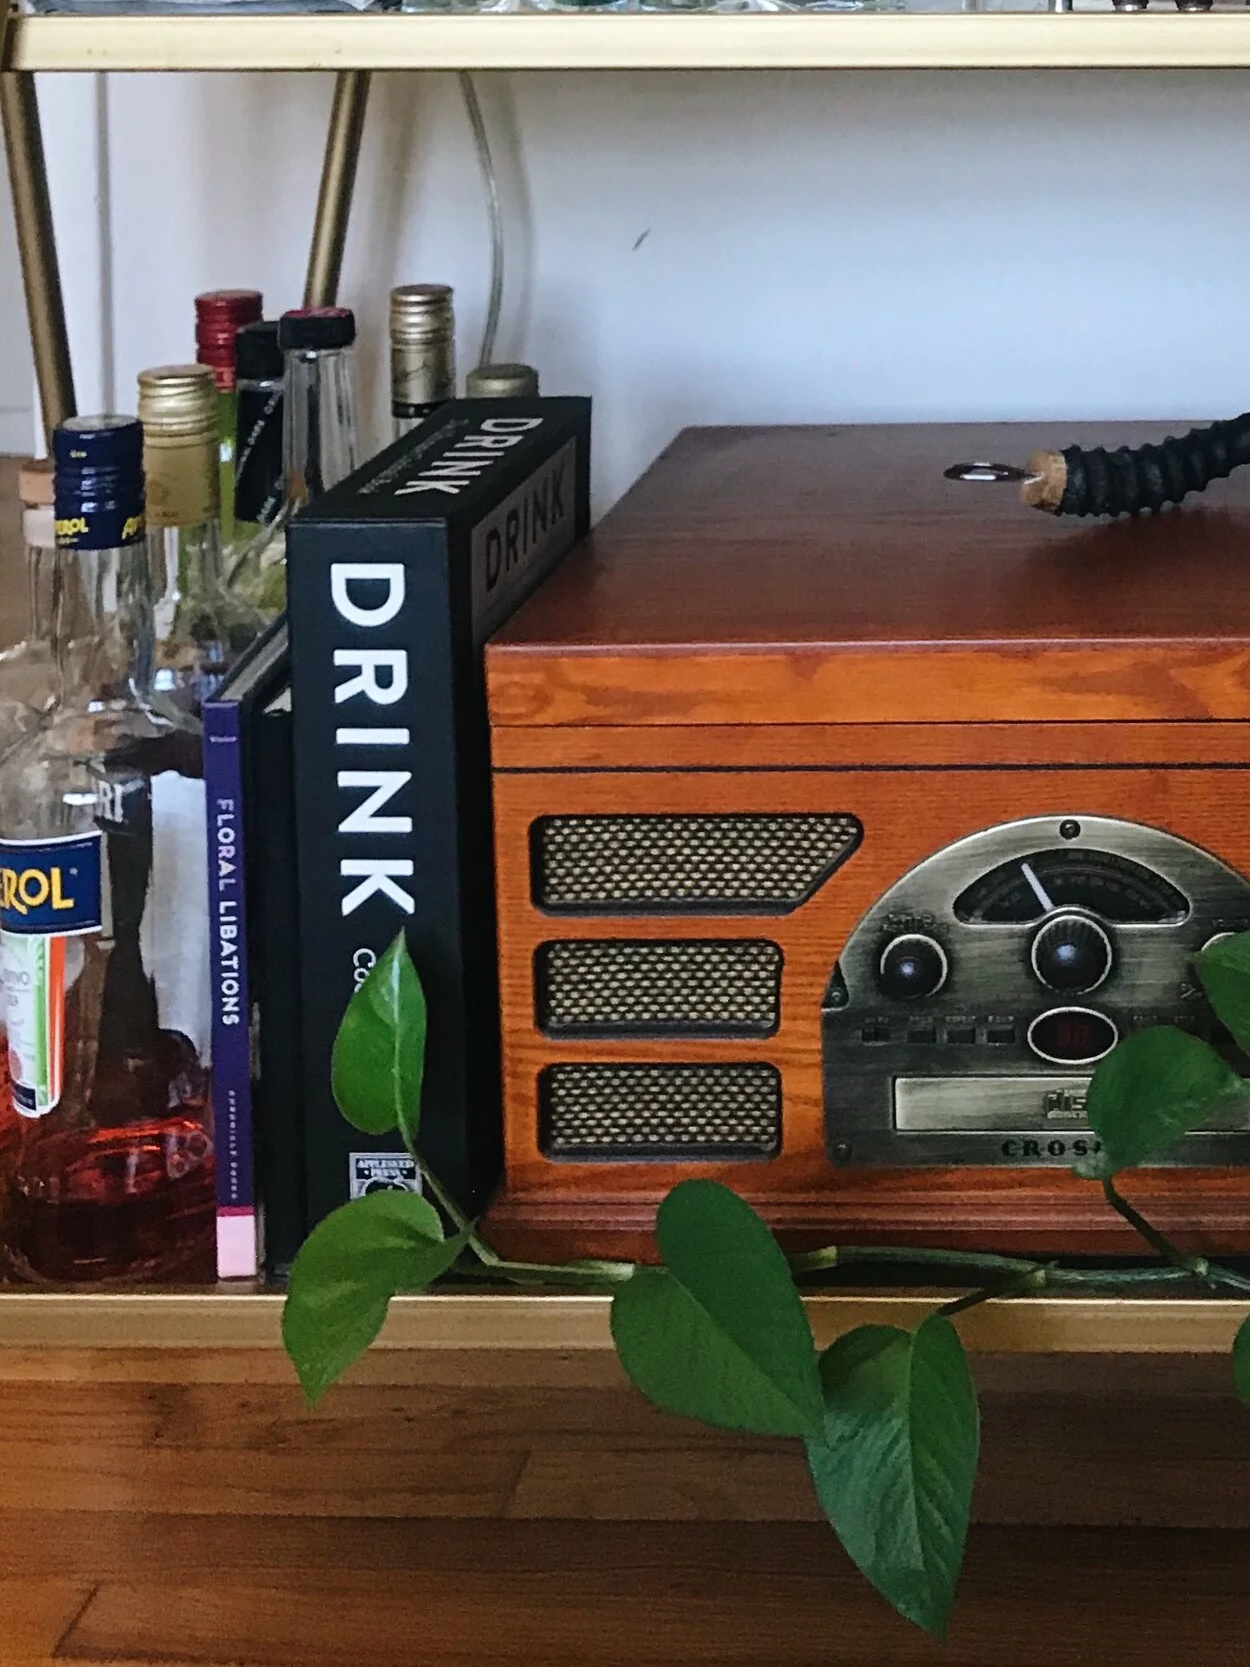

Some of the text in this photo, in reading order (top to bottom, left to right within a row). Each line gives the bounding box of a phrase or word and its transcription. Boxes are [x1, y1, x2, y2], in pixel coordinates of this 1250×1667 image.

[394, 417, 544, 496] DRINK
[486, 462, 566, 592] DRINK
[330, 562, 415, 917] DRINK
[216, 798, 239, 1026] FLORAL LIBATIONS
